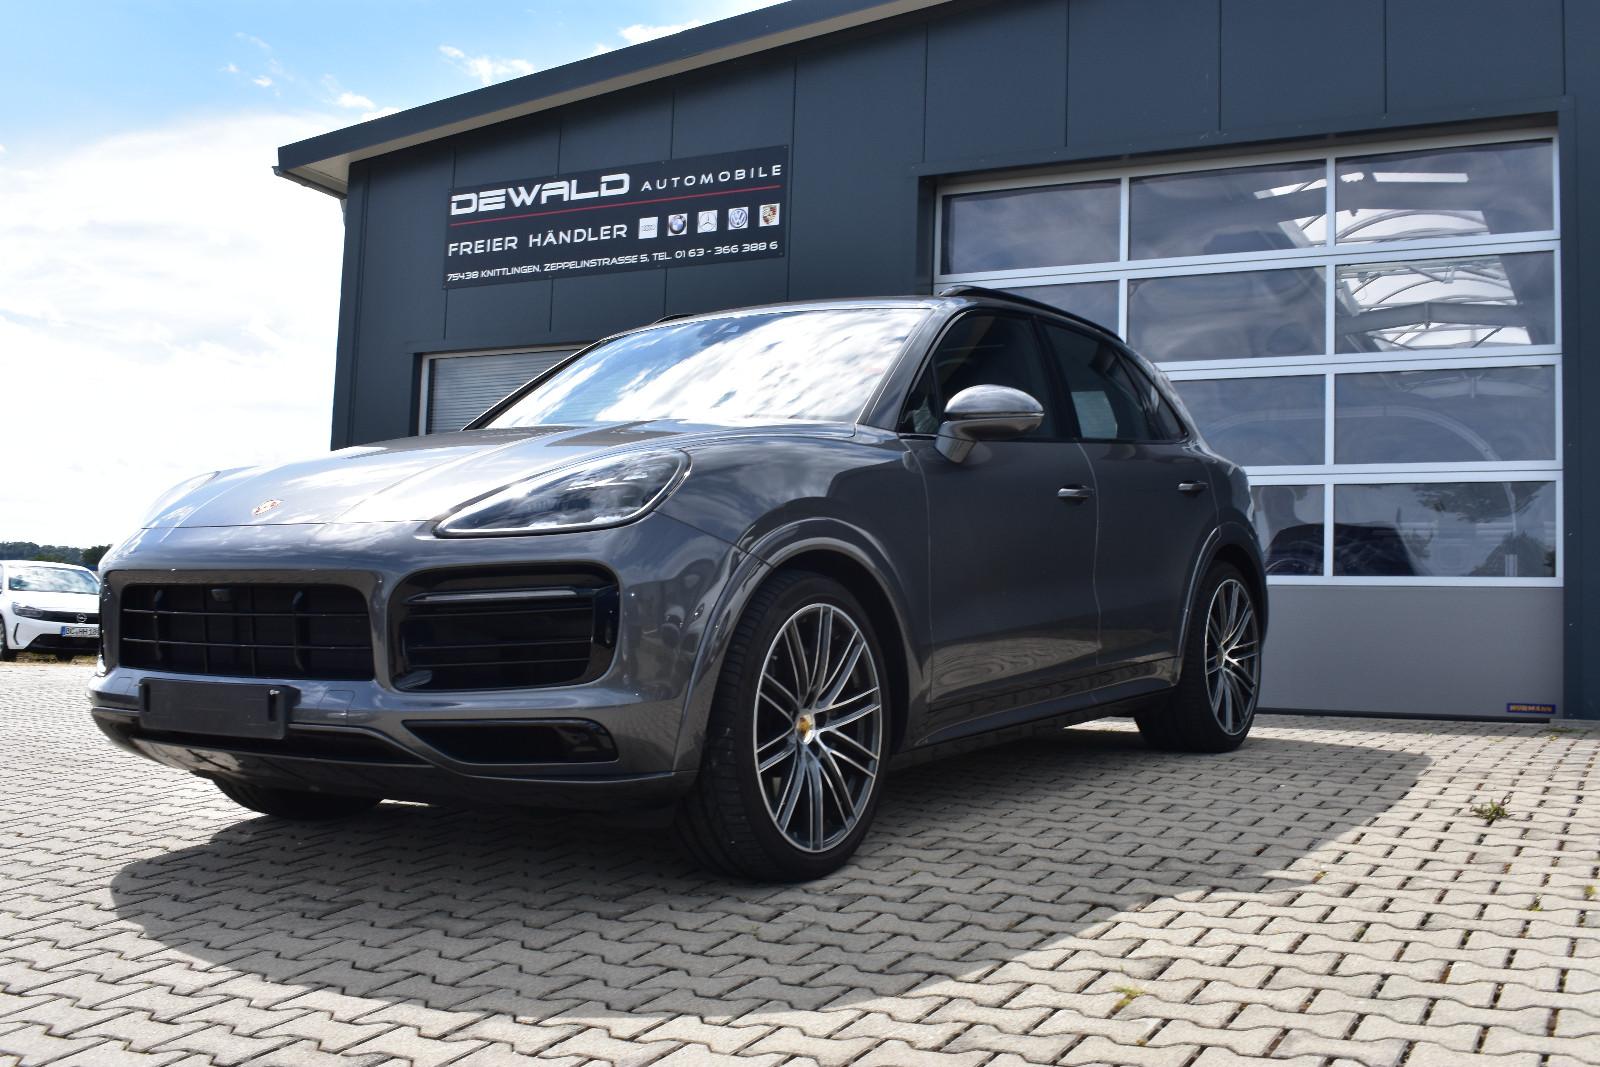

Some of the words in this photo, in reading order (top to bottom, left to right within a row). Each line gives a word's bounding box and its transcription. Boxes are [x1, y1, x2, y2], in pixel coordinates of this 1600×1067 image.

[450, 173, 630, 216] DEWALD
[641, 164, 782, 192] AUTOMOBILE
[448, 236, 518, 257] FREIER
[528, 224, 628, 248] HÄNDLER
[447, 271, 479, 282] 75438
[481, 264, 542, 277] KNITTLINGEN,
[543, 254, 638, 271] ZEPPELINSTRASSE
[714, 245, 739, 255] 366
